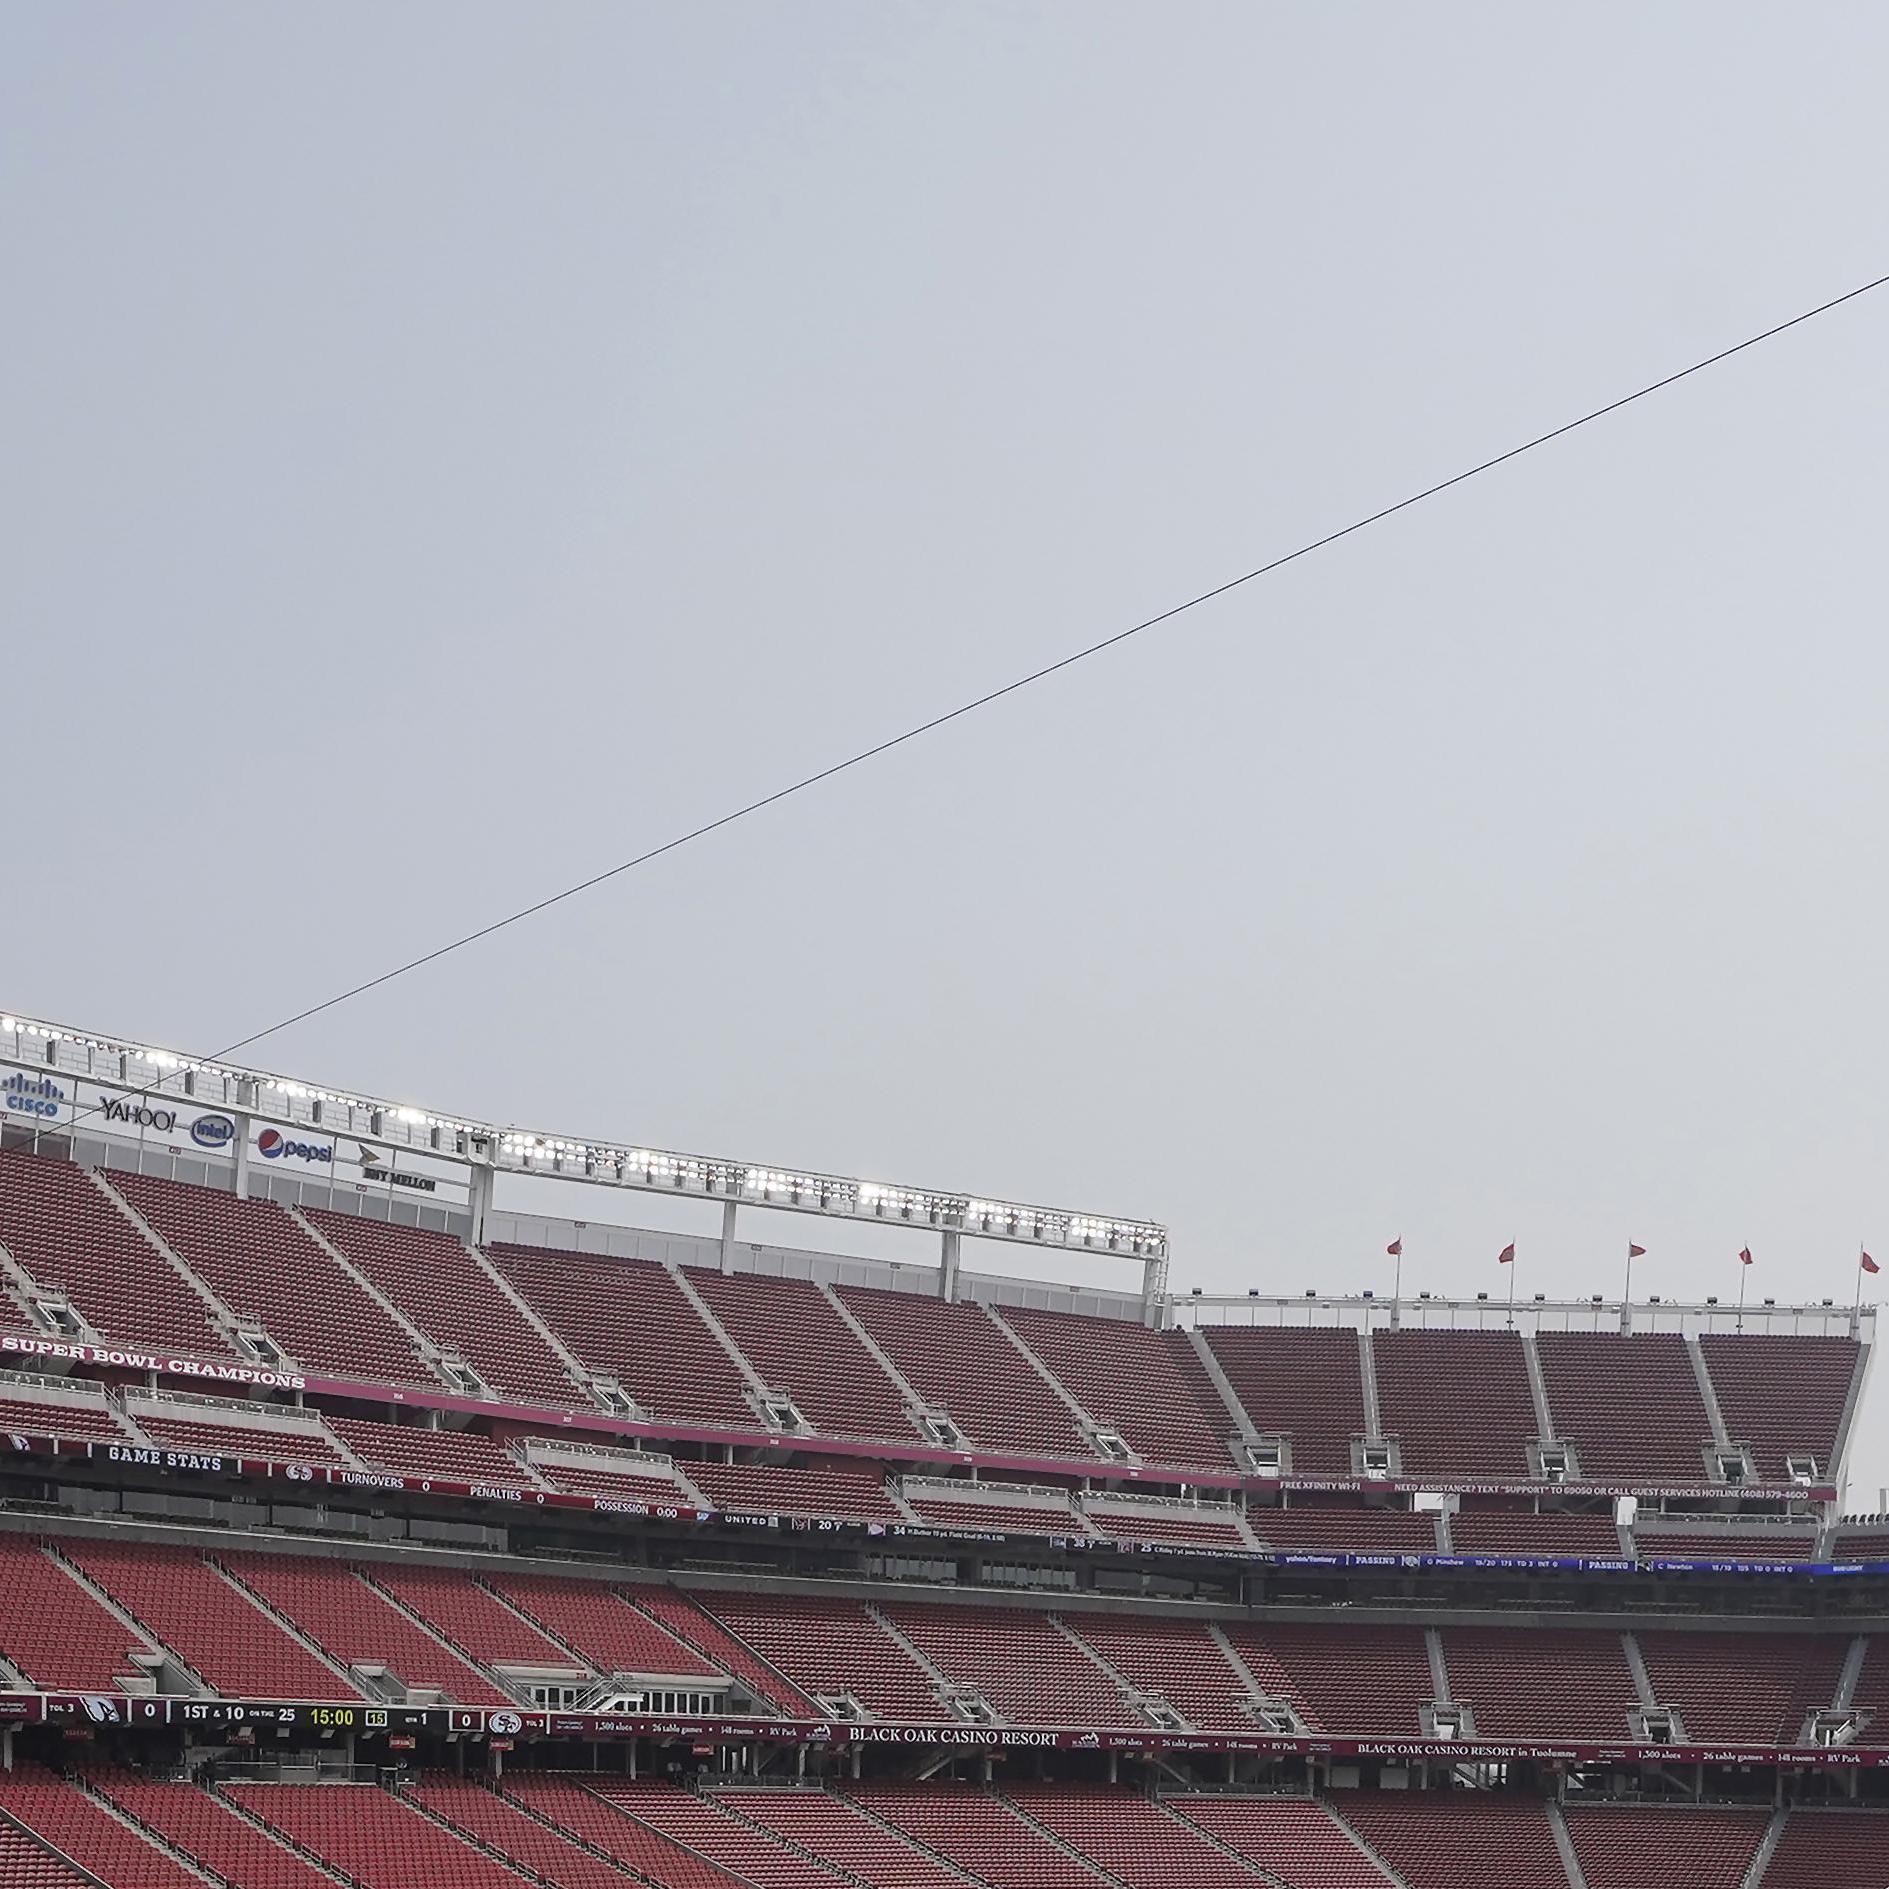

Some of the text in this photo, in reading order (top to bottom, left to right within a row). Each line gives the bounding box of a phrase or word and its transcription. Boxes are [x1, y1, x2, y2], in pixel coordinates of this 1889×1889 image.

[100, 1097, 176, 1133] YAHOO!
[196, 1121, 230, 1139] intel
[283, 1140, 333, 1163] pepsi
[1, 1337, 86, 1359] SUPER
[93, 1348, 162, 1370] BOWL
[168, 1360, 306, 1389] CHAMPIONS
[109, 1447, 221, 1471] GAME STATS
[340, 1472, 649, 1515] TURNOVERS PENALTIES POSSESSION
[1301, 1482, 1740, 1498] XFINITY ASSISTANCE? GUEST SERVICES HOTLINE
[725, 1515, 767, 1526] UNITED
[144, 1703, 384, 1725] 0 1ST 10 25 15:00 15
[849, 1727, 1059, 1747] BLACK OAK CASINO RESORT
[1358, 1744, 1578, 1759] BLACK OAK CASINO RESORT Tuolumne
